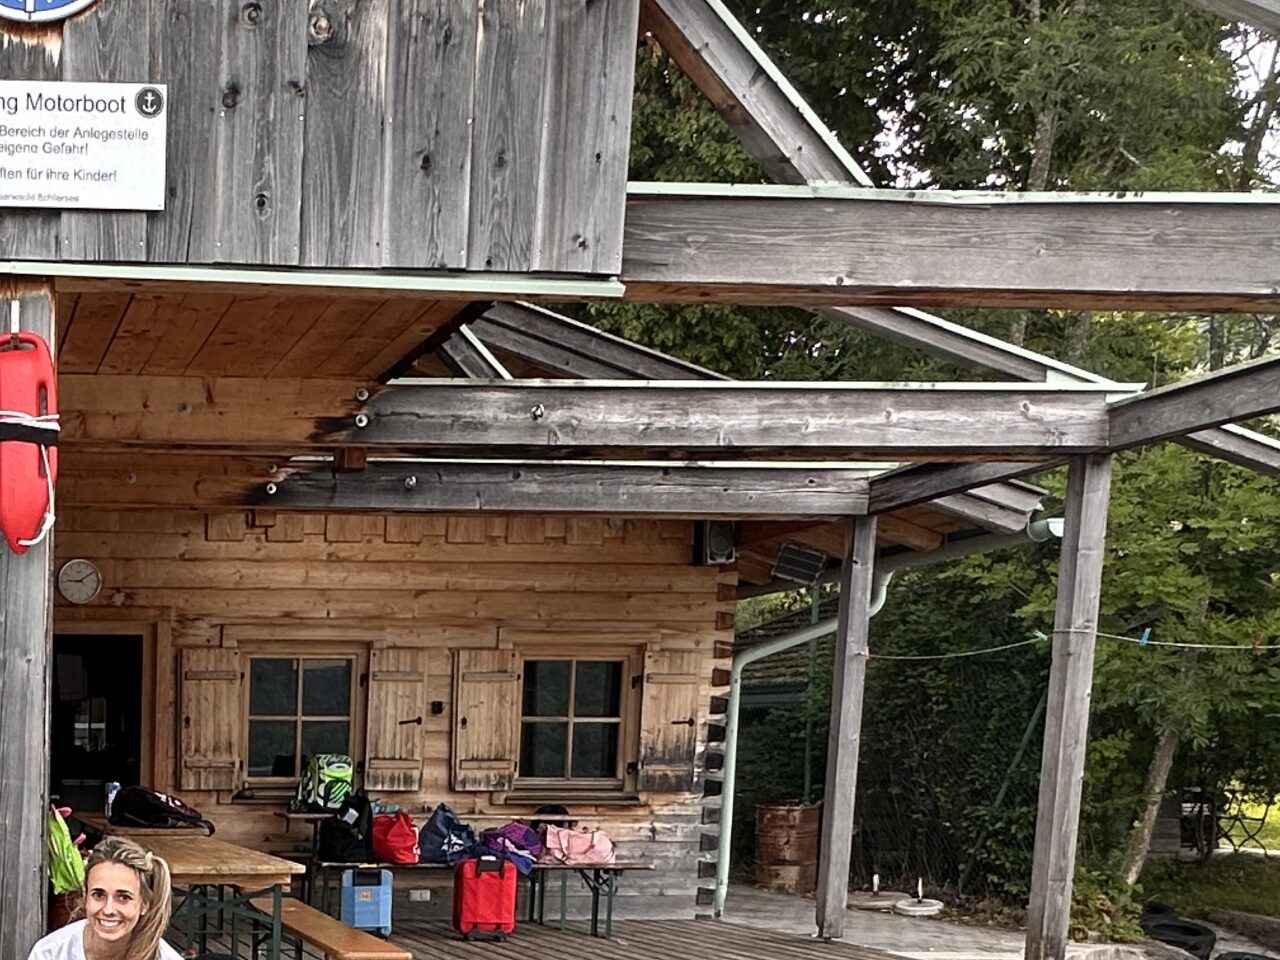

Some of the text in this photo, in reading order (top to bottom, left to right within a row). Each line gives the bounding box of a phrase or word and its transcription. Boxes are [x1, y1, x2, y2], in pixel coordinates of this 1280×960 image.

[26, 92, 126, 114] Motorboot
[0, 124, 46, 137] Bereich
[49, 126, 69, 138] der
[73, 126, 149, 142] Anlegestelle
[42, 141, 88, 155] Gefahr!
[26, 167, 43, 180] für
[46, 168, 69, 180] ihre
[73, 168, 117, 182] Kinder!
